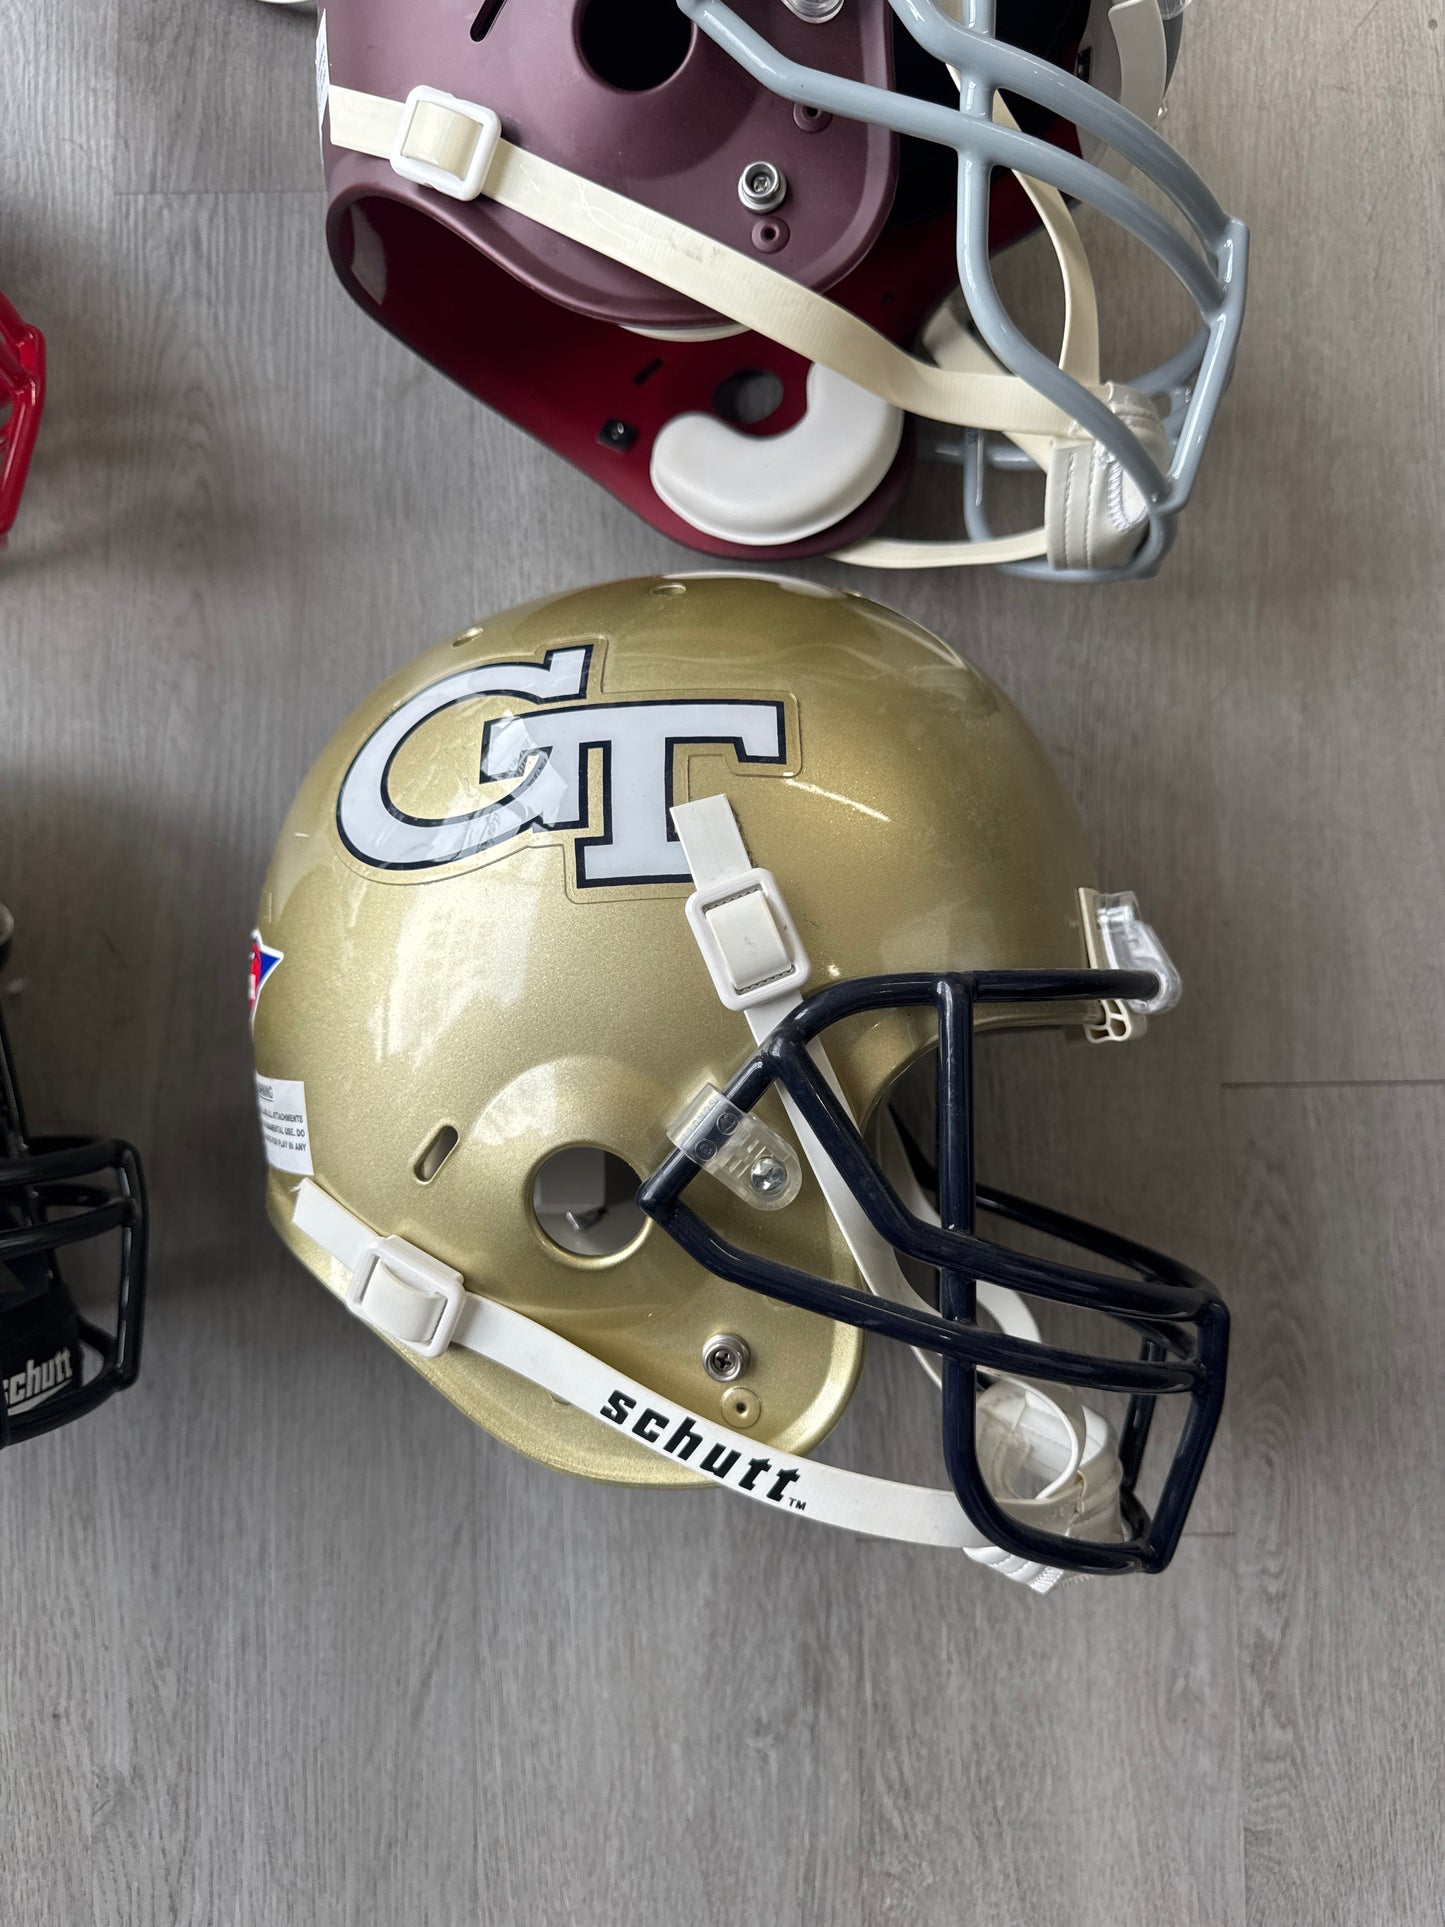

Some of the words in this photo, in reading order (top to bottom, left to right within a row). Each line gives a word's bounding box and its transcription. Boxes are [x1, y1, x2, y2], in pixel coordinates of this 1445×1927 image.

[296, 1128, 305, 1138] DO
[295, 1142, 307, 1151] ANY
[600, 1389, 801, 1503] schutt
